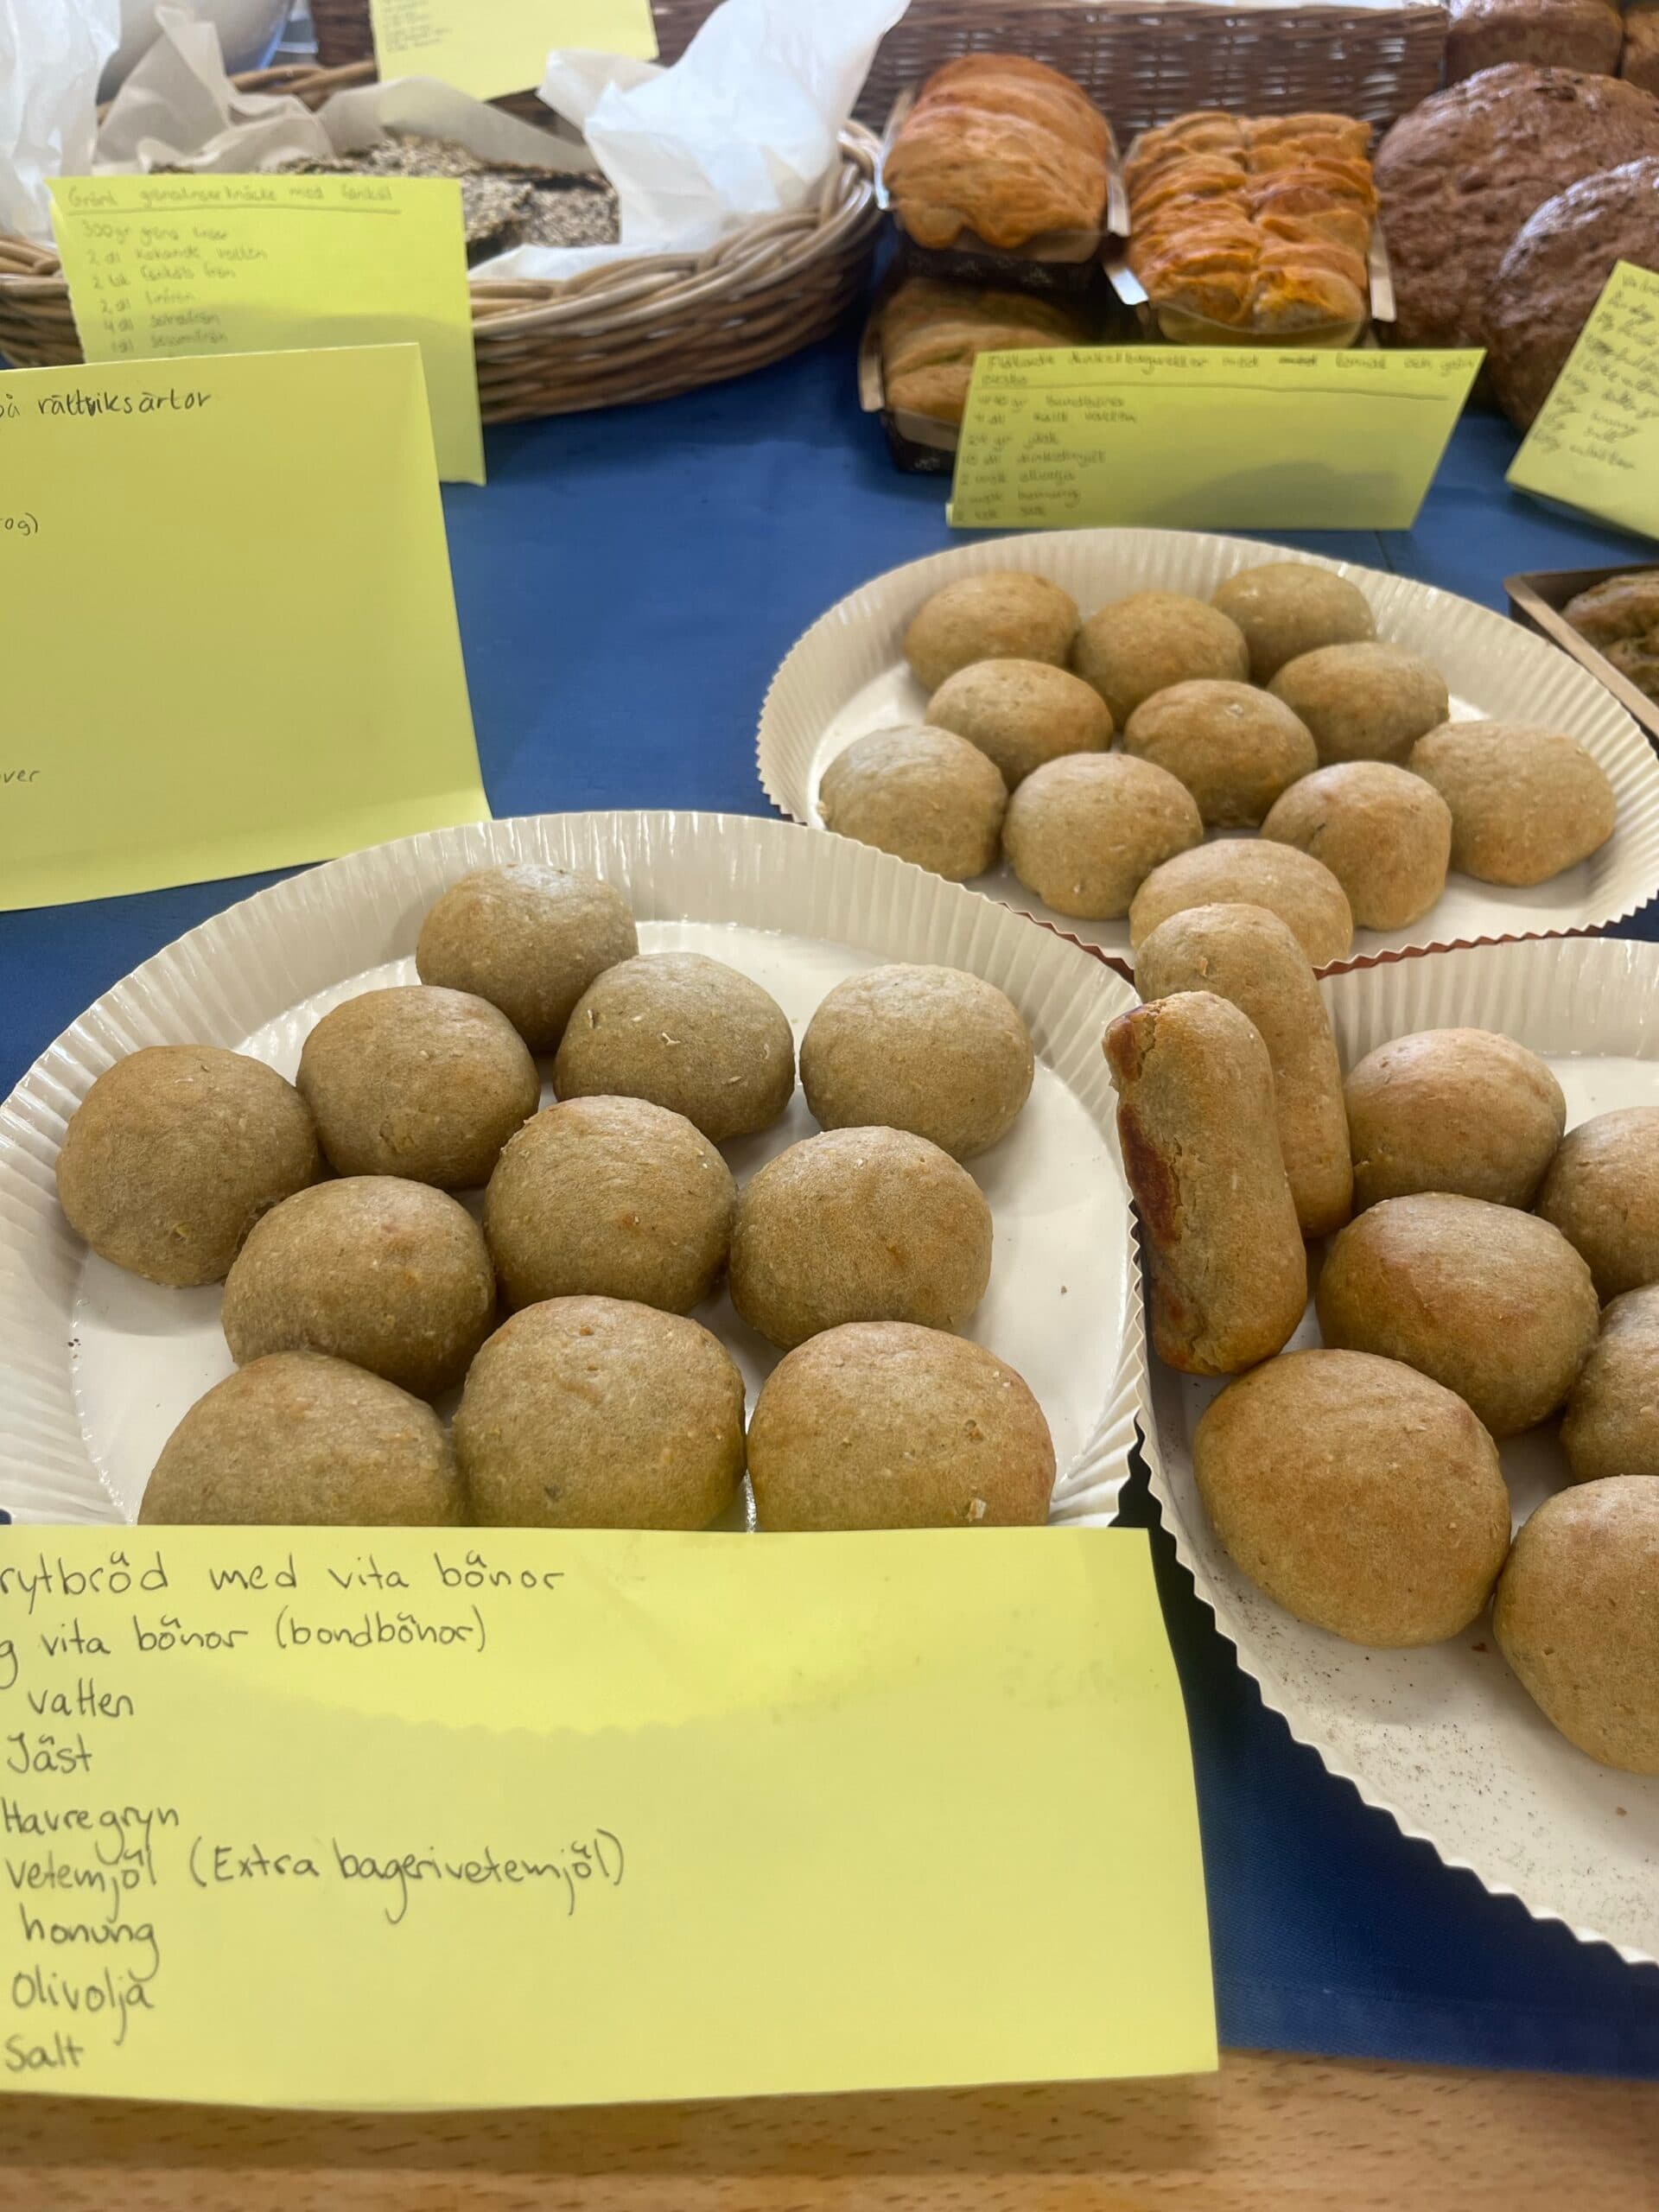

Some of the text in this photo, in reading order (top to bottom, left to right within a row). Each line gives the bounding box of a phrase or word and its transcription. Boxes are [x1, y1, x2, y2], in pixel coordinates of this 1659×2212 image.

[0, 512, 39, 537] og)
[0, 769, 41, 784] ver
[208, 1553, 298, 1592] med
[327, 1554, 410, 1591] vita
[434, 1550, 565, 1591] bönor
[41, 1617, 112, 1657] vita
[132, 1614, 250, 1652] bönor
[275, 1605, 486, 1654] (bondbönor)
[27, 1677, 135, 1718] vatten
[7, 1731, 93, 1774] Jäst
[0, 1796, 180, 1866] Havregryn
[189, 1835, 321, 1888] (Extra
[333, 1827, 625, 1925] bagerivetemjöl)
[19, 1902, 161, 1982] honung
